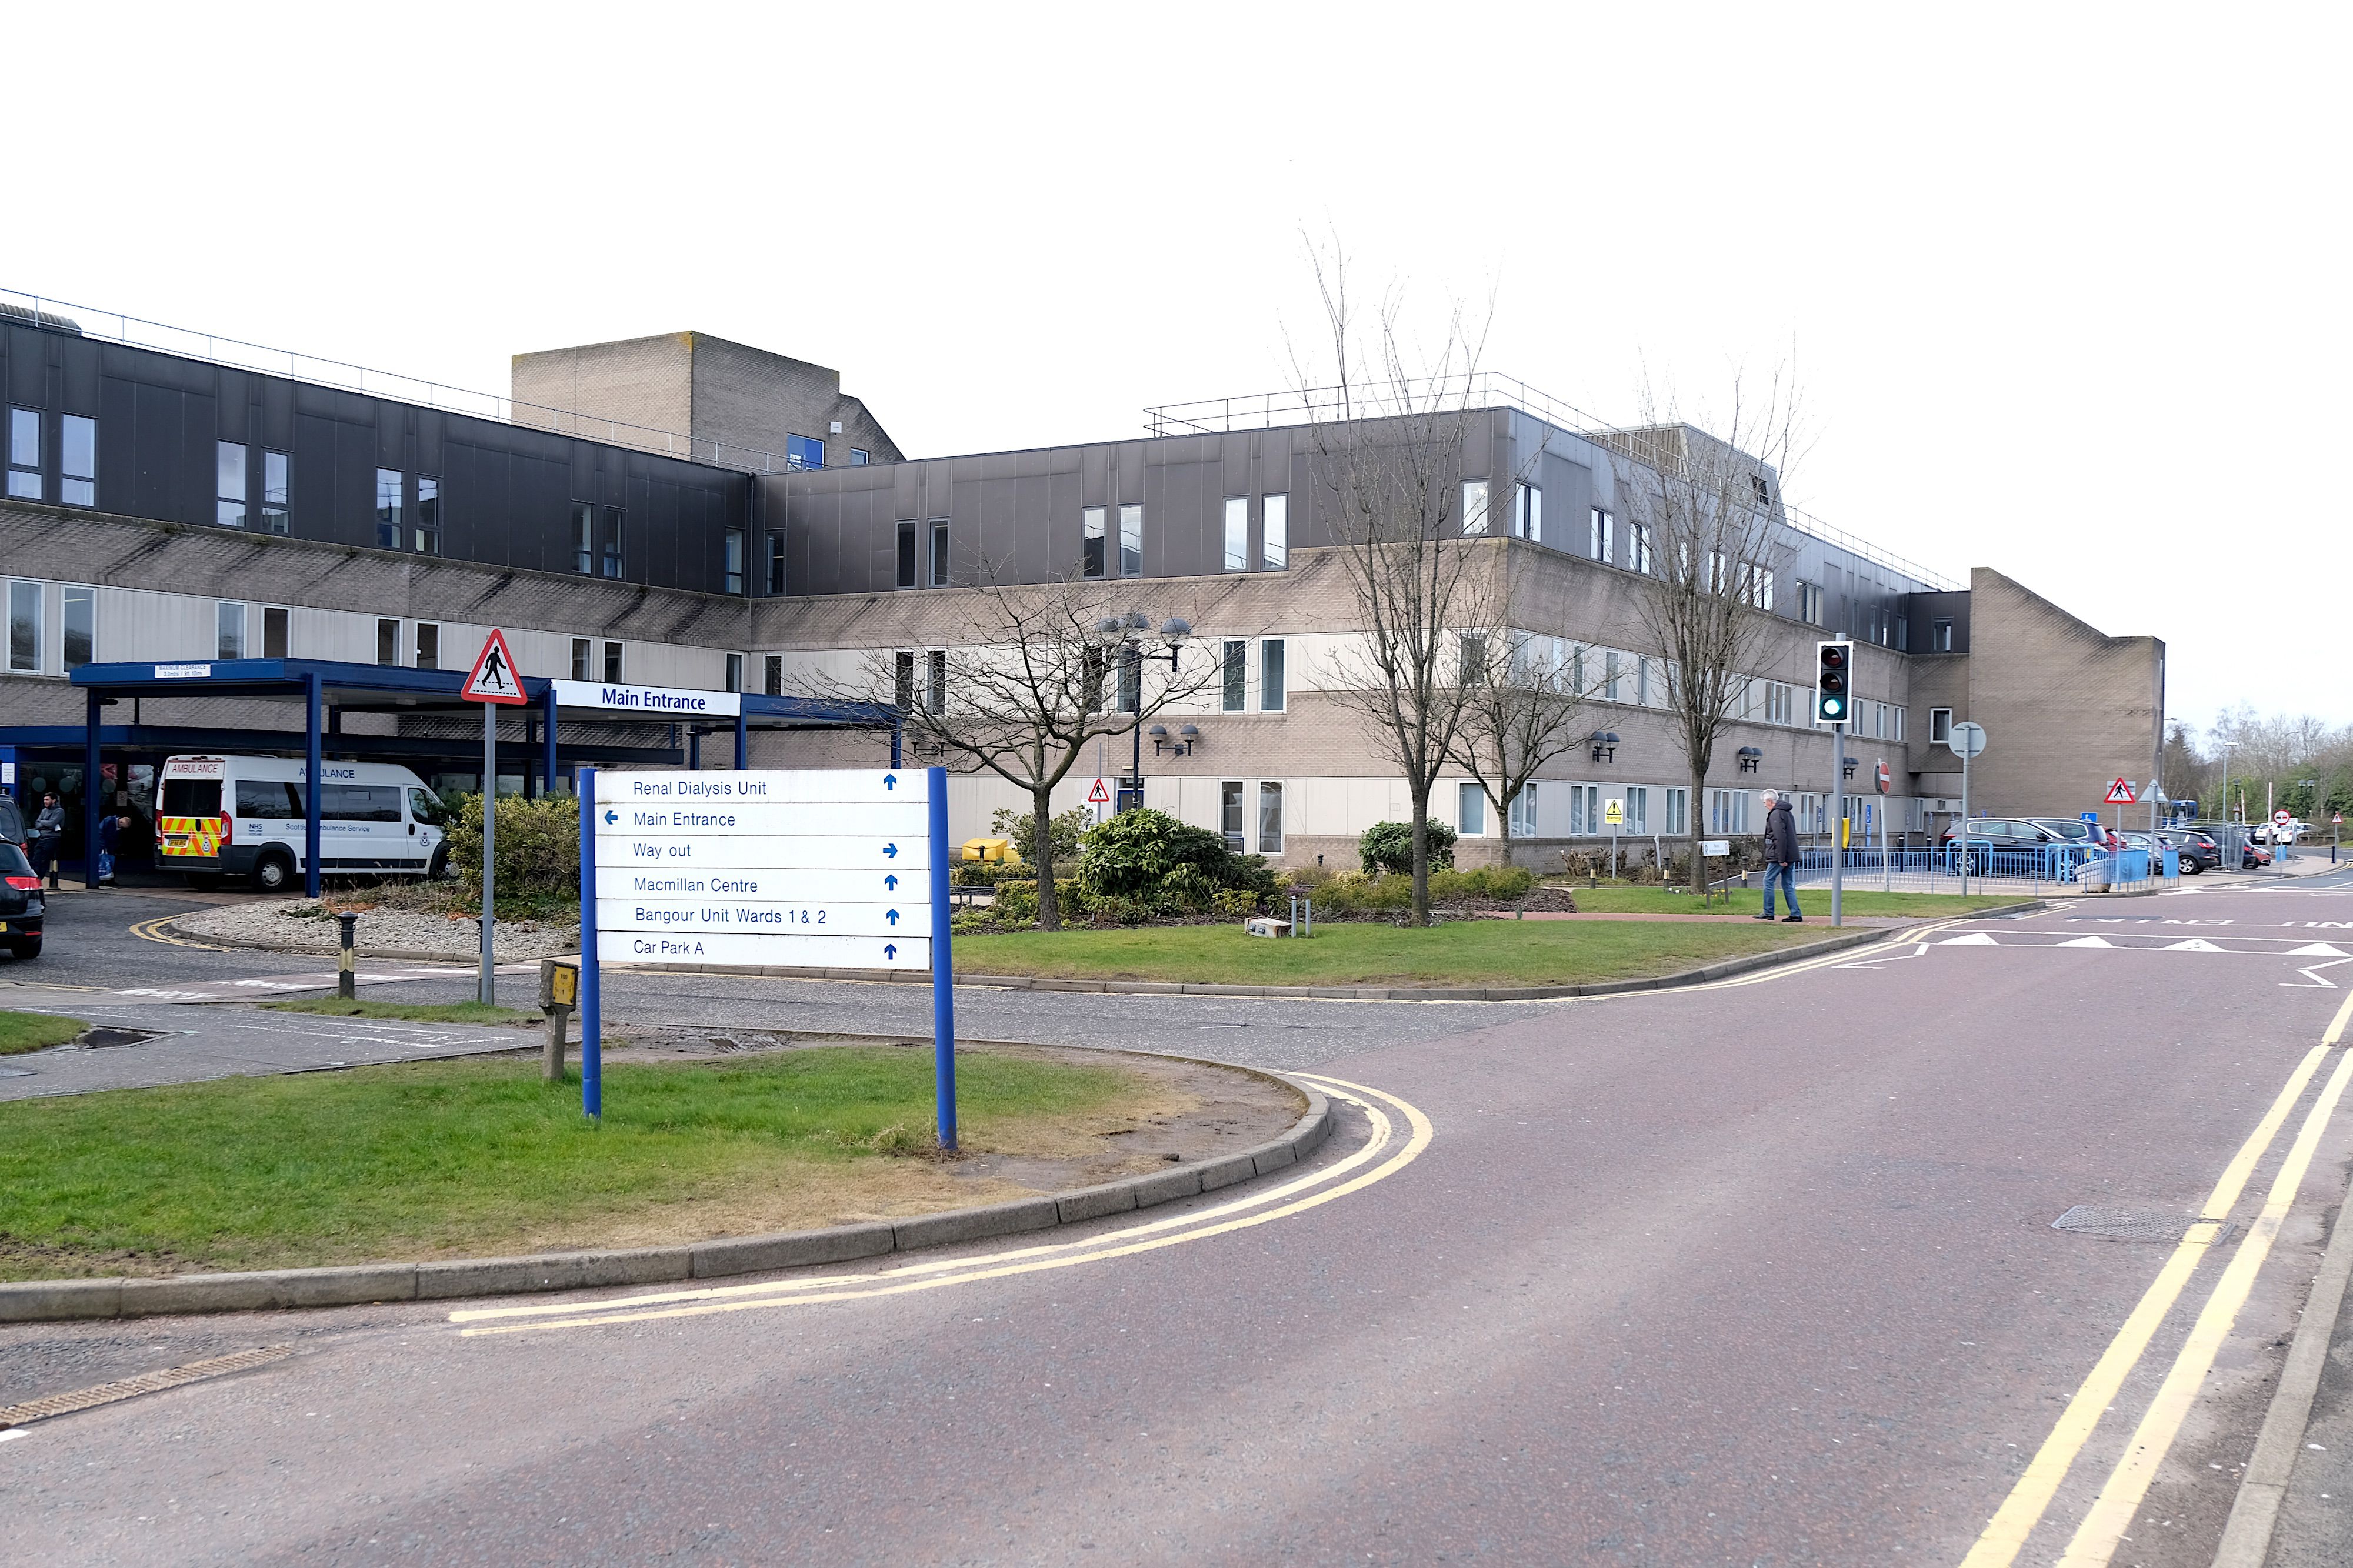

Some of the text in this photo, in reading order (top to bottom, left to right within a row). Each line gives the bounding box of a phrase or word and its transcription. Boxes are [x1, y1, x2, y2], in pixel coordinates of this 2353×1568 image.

[602, 688, 705, 710] Main Entrance
[172, 764, 218, 773] AMBULANCE
[299, 768, 355, 778] AULANCE
[634, 781, 766, 797] Renal Dialysis Unit
[634, 812, 735, 826] Main Entrance
[633, 843, 691, 859] Way out
[635, 878, 758, 892] Macmillan Centre
[636, 908, 826, 924] Bangour Unit Wards 1 & 2
[634, 940, 704, 955] Car Park A
